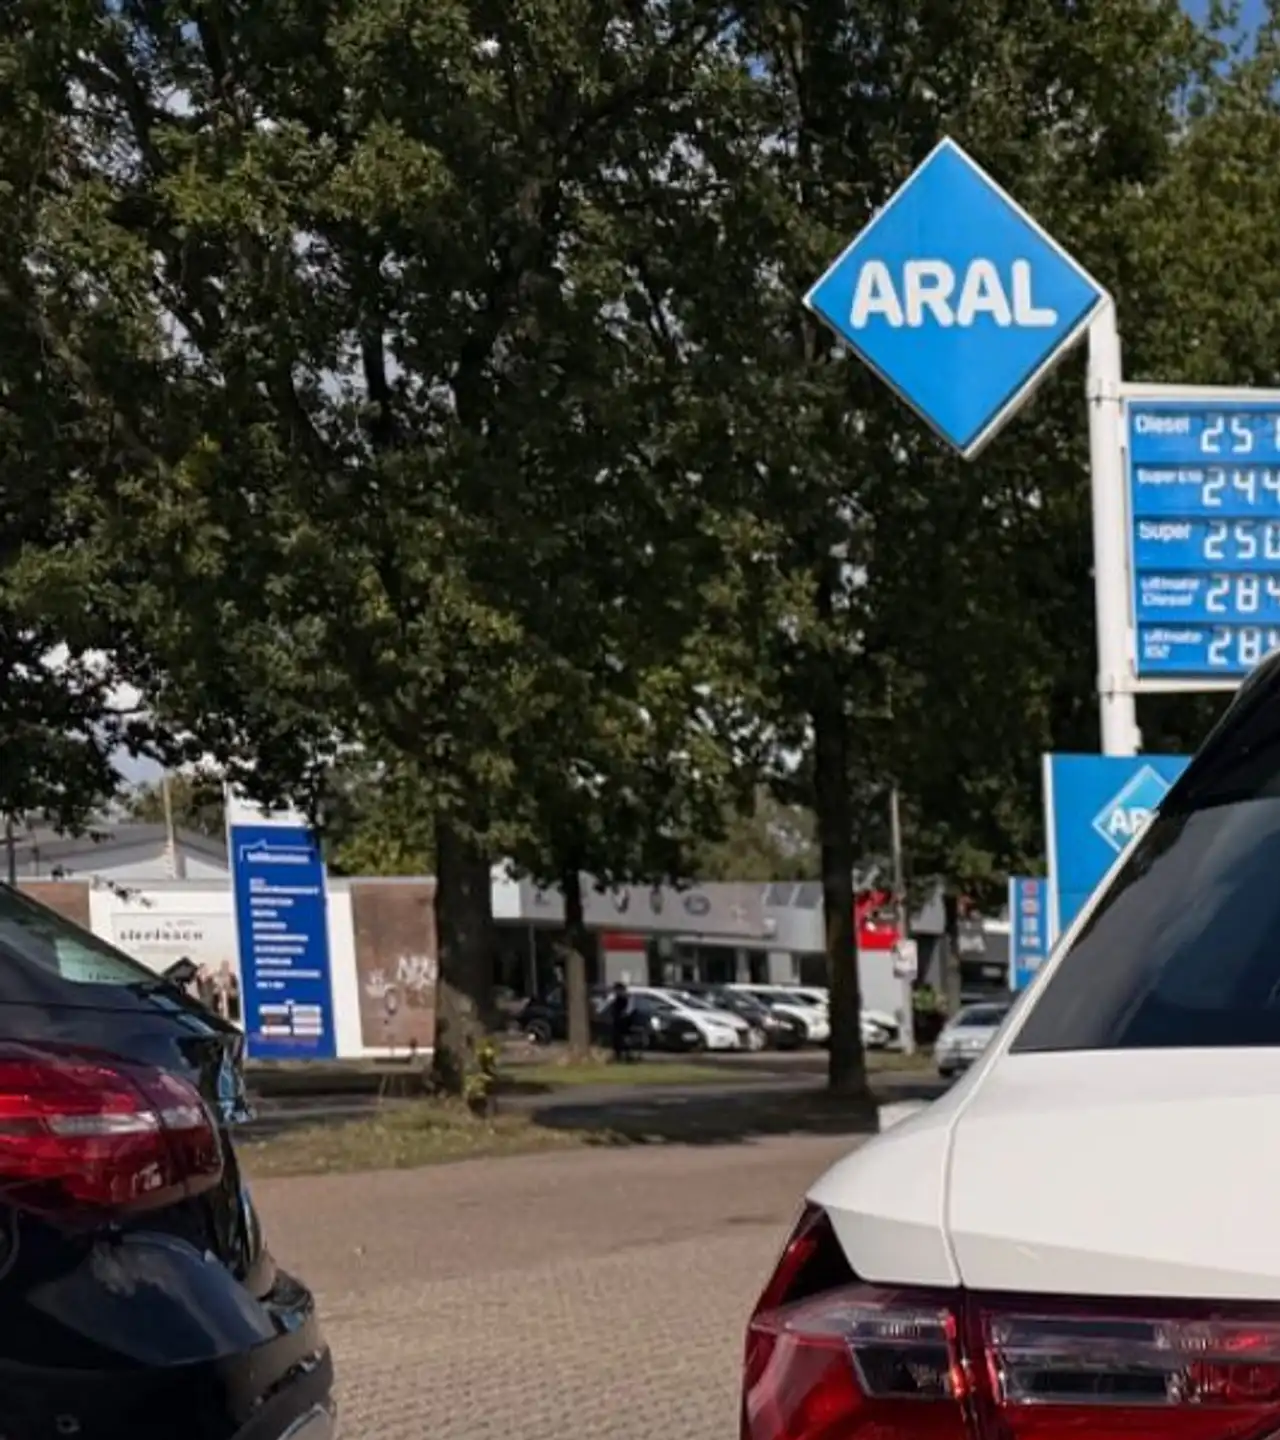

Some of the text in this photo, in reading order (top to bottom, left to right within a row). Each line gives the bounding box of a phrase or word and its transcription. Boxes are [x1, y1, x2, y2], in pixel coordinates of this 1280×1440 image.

[850, 258, 1058, 329] ARAL
[1134, 414, 1190, 434] Diesel
[1138, 521, 1191, 542] Super
